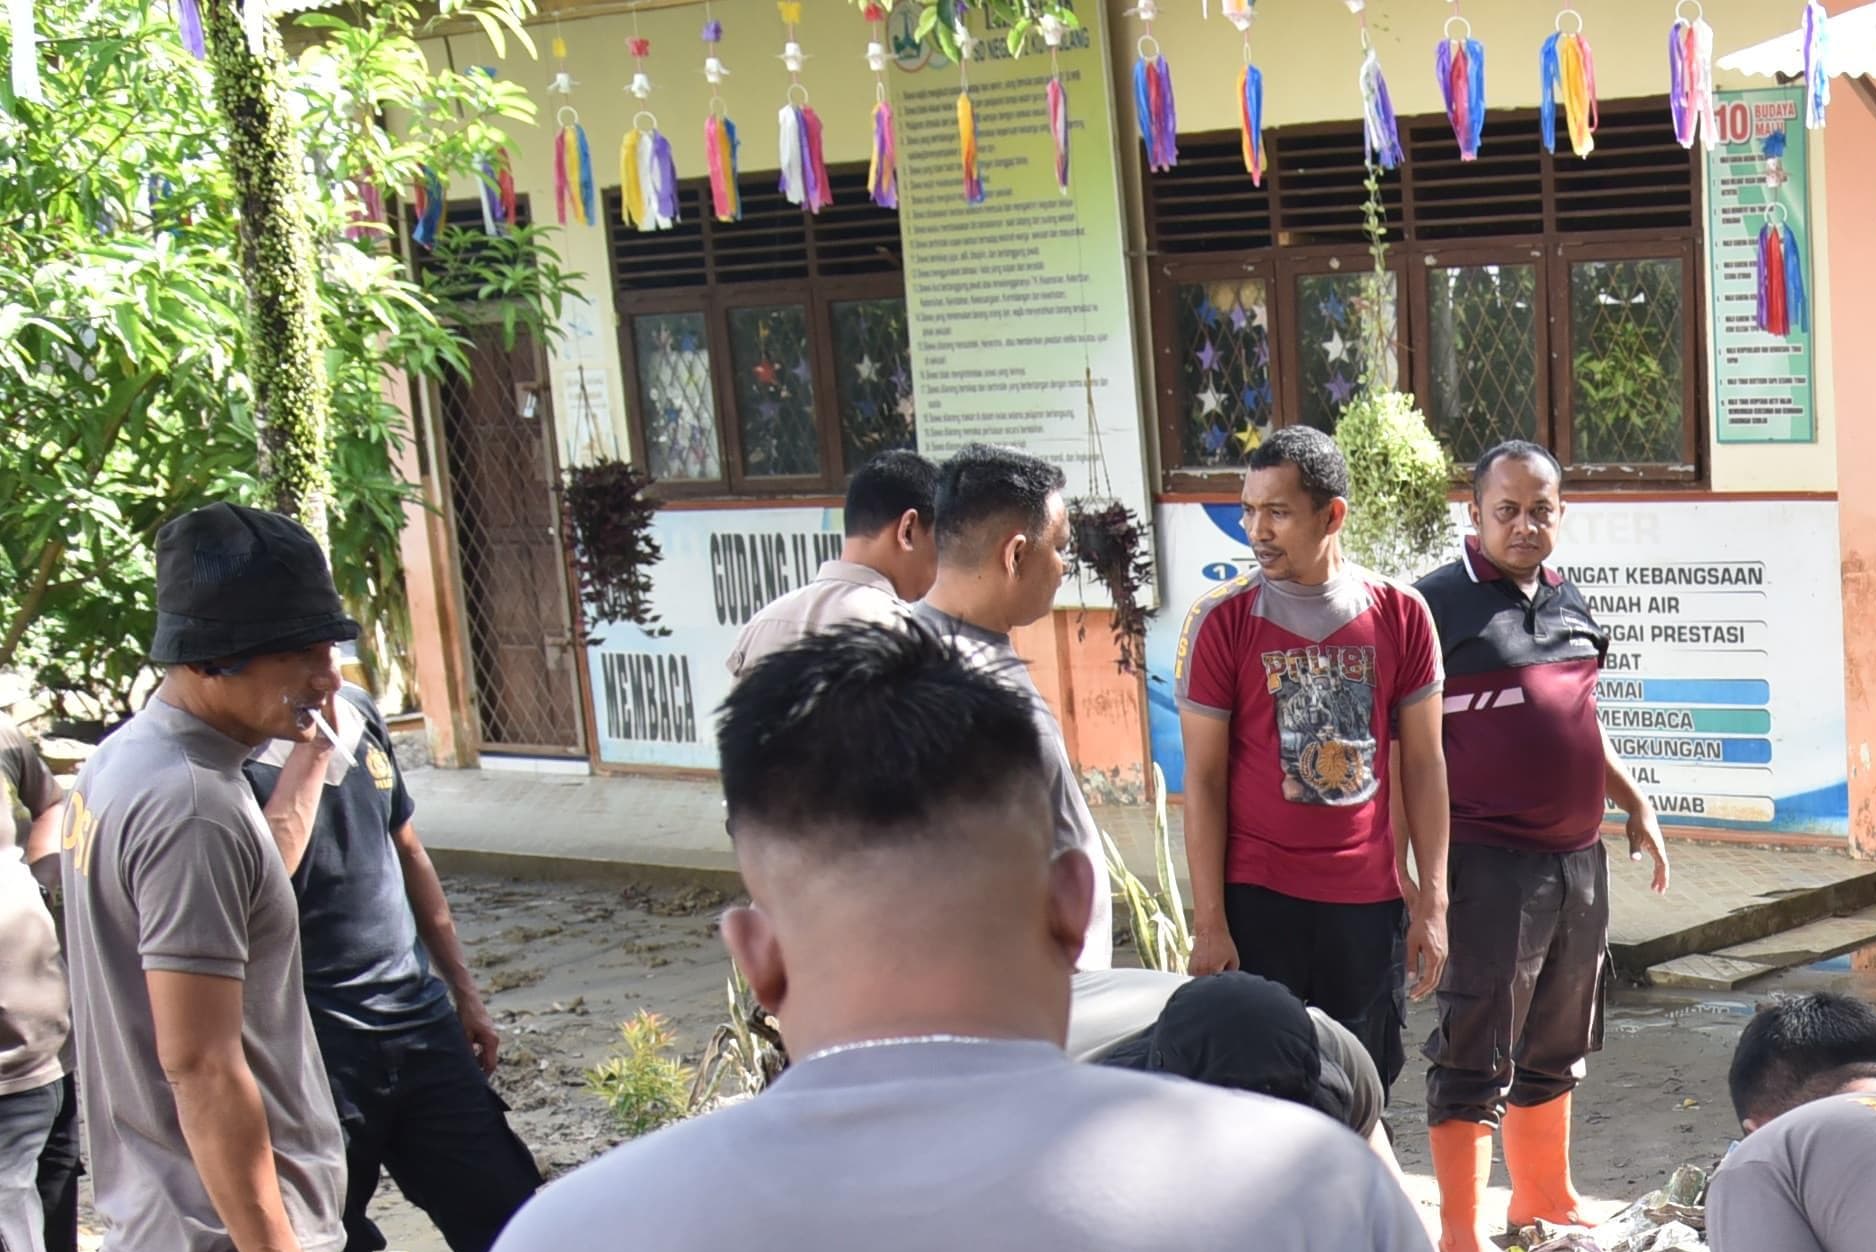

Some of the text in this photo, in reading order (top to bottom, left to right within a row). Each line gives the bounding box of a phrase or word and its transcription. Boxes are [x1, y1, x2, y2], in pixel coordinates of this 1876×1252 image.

[1754, 102, 1795, 118] BUDAYA
[1714, 103, 1749, 141] 10
[710, 532, 789, 627] GUDANG
[1557, 566, 1763, 585] ANGAT KEBANGSAAN
[1584, 595, 1680, 614] ANAH AIR
[1600, 624, 1644, 642] RGAI
[1651, 625, 1745, 643] PRESTASI
[1261, 645, 1377, 695] POLISI
[1607, 653, 1642, 670] BAT
[601, 652, 696, 743] MEMBACA
[1594, 681, 1643, 699] AMAI
[1609, 738, 1721, 759] NGKUNGAN
